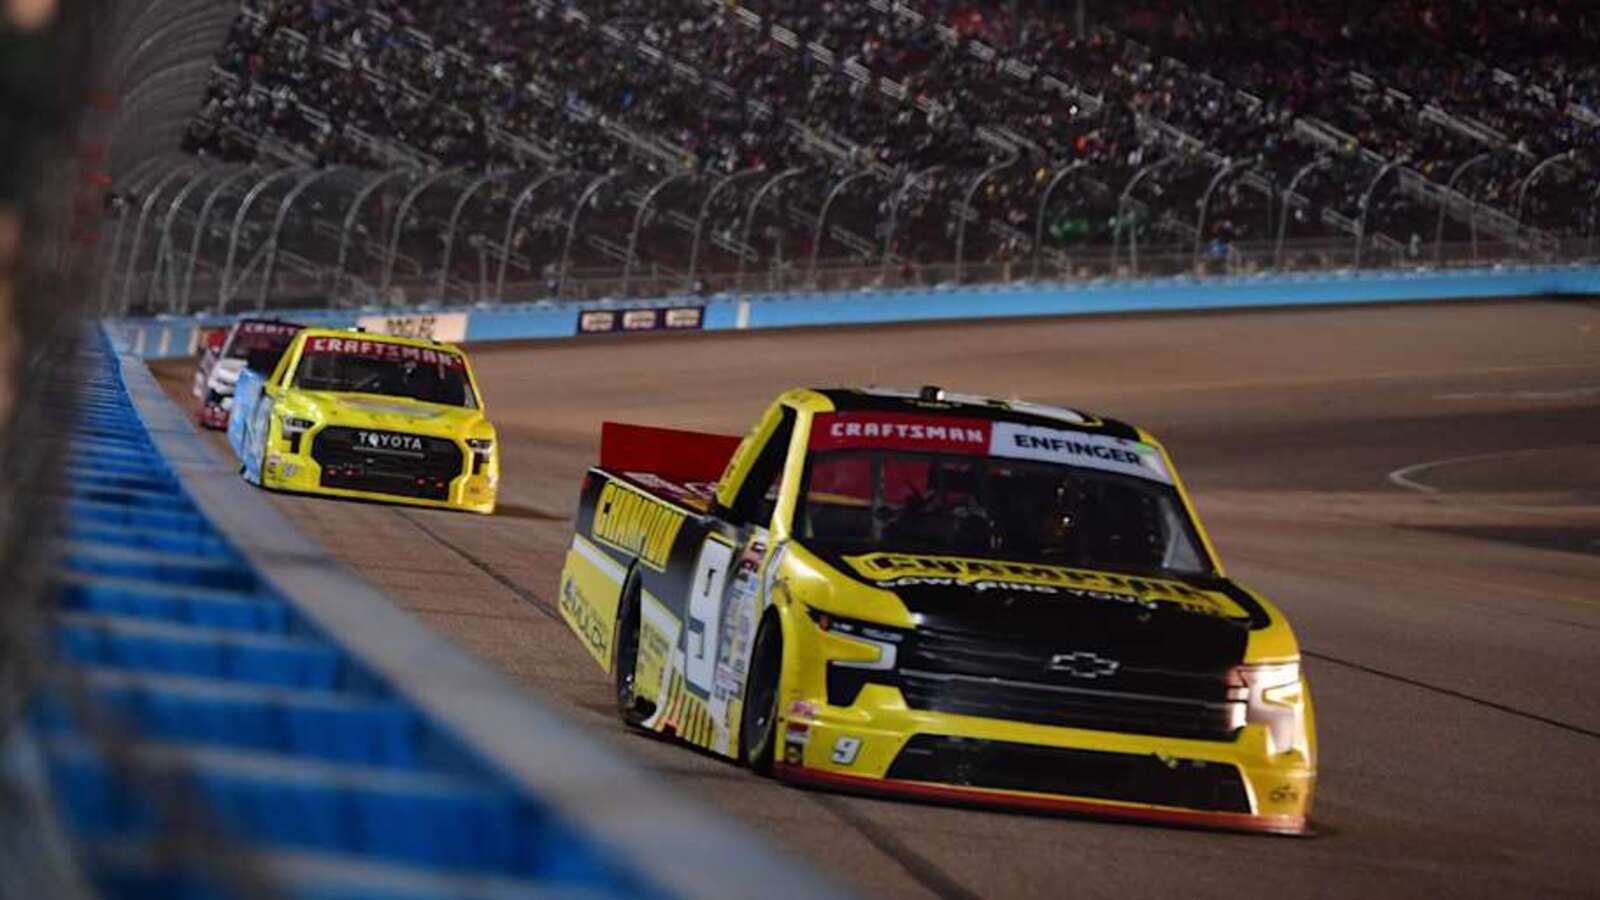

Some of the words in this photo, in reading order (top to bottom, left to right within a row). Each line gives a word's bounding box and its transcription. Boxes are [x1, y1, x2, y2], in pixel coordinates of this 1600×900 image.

[313, 338, 452, 367] CRAFTSMAN
[358, 432, 422, 449] TOYOTA
[830, 421, 983, 442] CRAFTSMAN
[1014, 434, 1141, 465] ENFINGER
[592, 482, 686, 571] CHAMPION
[685, 534, 733, 697] 9
[833, 735, 860, 764] 9
